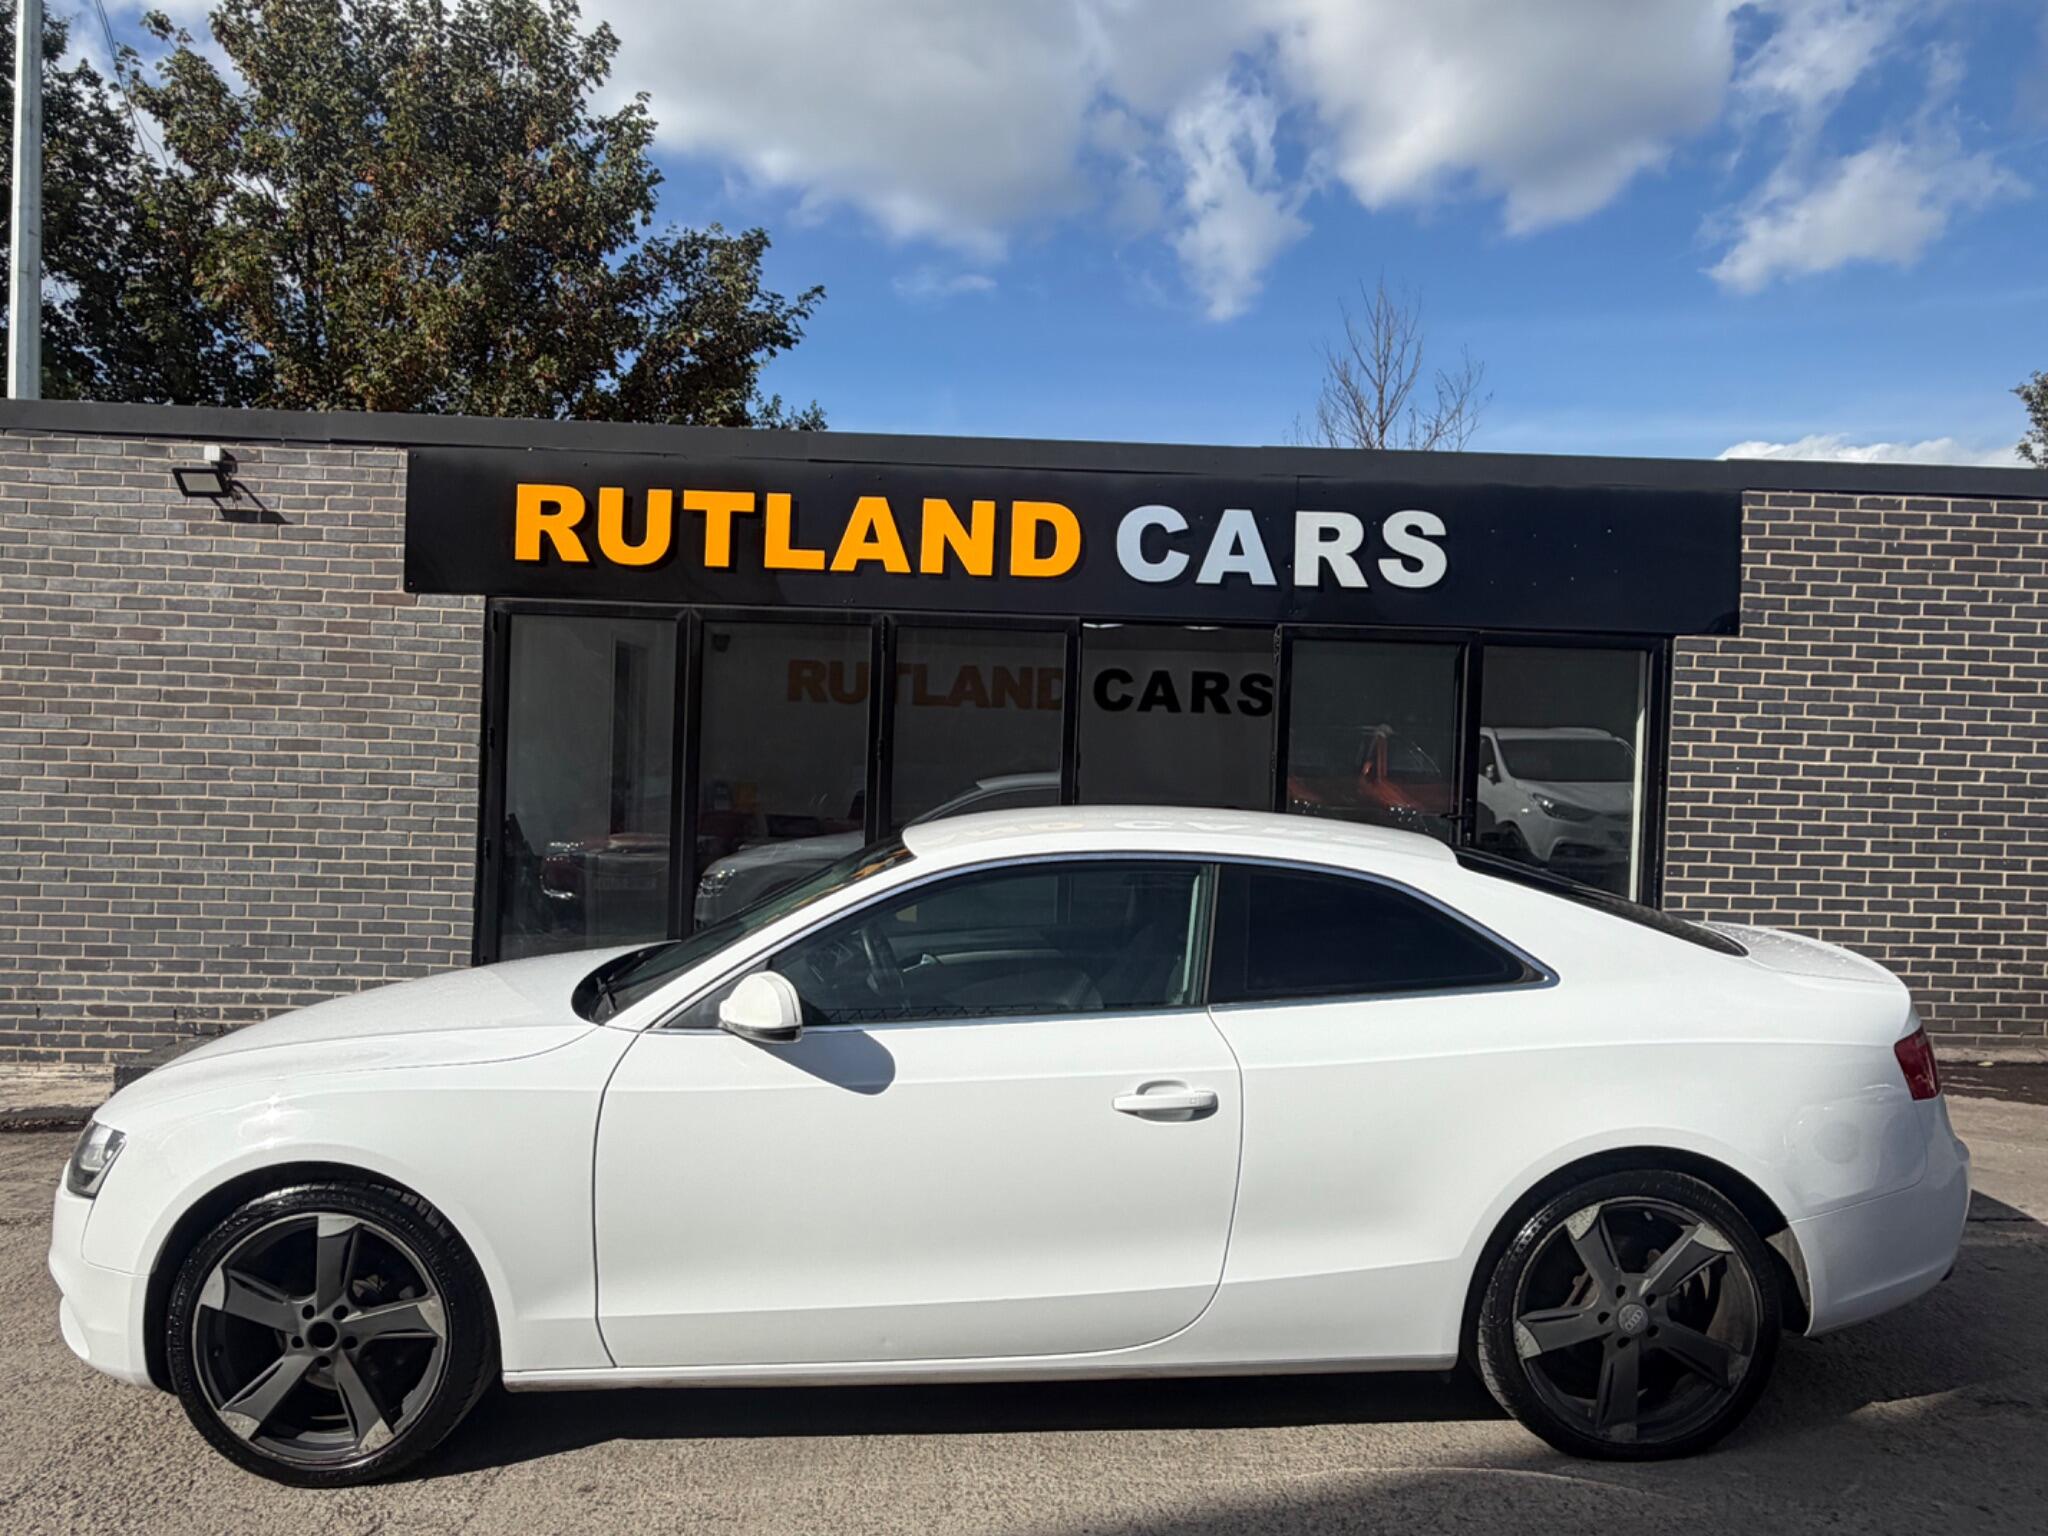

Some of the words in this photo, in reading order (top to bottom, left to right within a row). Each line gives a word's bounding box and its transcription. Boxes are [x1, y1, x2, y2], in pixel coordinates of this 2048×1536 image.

[514, 483, 1083, 578] RUTLAND
[1116, 504, 1449, 589] CARS
[1093, 668, 1274, 718] CARS
